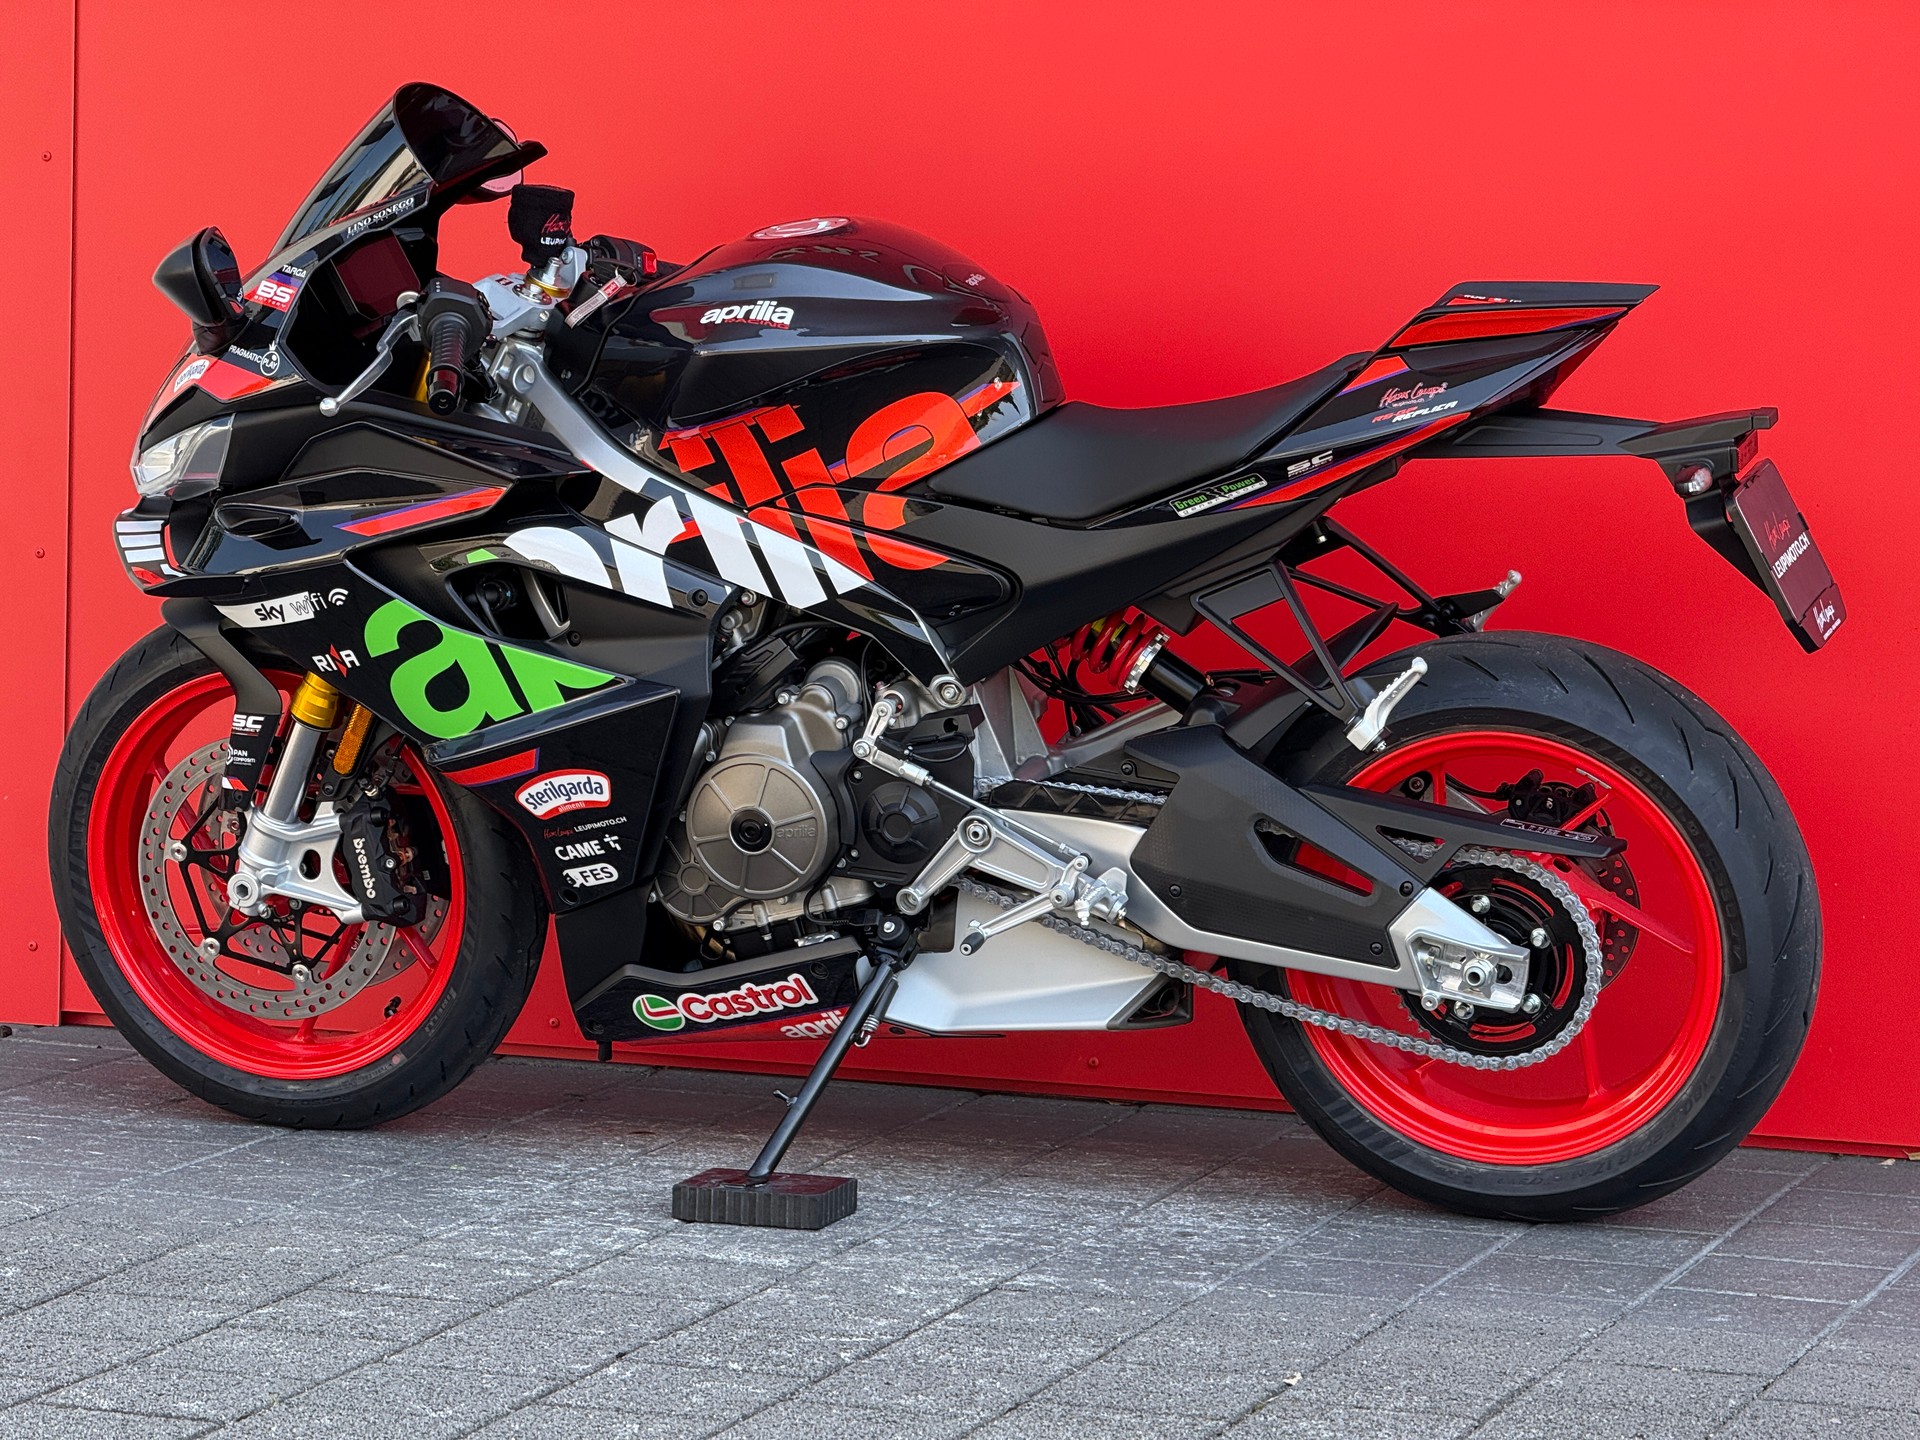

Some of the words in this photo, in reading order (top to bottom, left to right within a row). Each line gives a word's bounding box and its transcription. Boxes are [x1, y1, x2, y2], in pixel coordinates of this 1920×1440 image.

[347, 216, 372, 235] LINO
[373, 197, 415, 220] SONEGO
[281, 264, 307, 278] TARGA
[256, 280, 294, 303] BS
[700, 300, 795, 325] aprilia
[724, 317, 790, 331] RACING
[228, 344, 263, 364] PRAGMATIC
[262, 358, 278, 370] PLAY
[1391, 400, 1459, 423] REPLICA
[1286, 449, 1334, 472] SC
[1174, 493, 1208, 511] Green
[1220, 476, 1257, 494] Power
[1772, 531, 1811, 580] LEUPIMOTO.CH
[254, 603, 286, 623] sky
[289, 592, 328, 616] wifi
[232, 713, 265, 729] SC
[233, 749, 248, 757] PAN
[524, 775, 604, 810] sterilgarda
[558, 801, 586, 813] alimenti
[573, 816, 628, 833] LEUPIMOTO.CH
[776, 825, 816, 840] aprilia
[554, 839, 606, 861] CAME
[352, 837, 376, 899] brembo
[578, 866, 615, 883] FES
[679, 974, 815, 1022] Castrol
